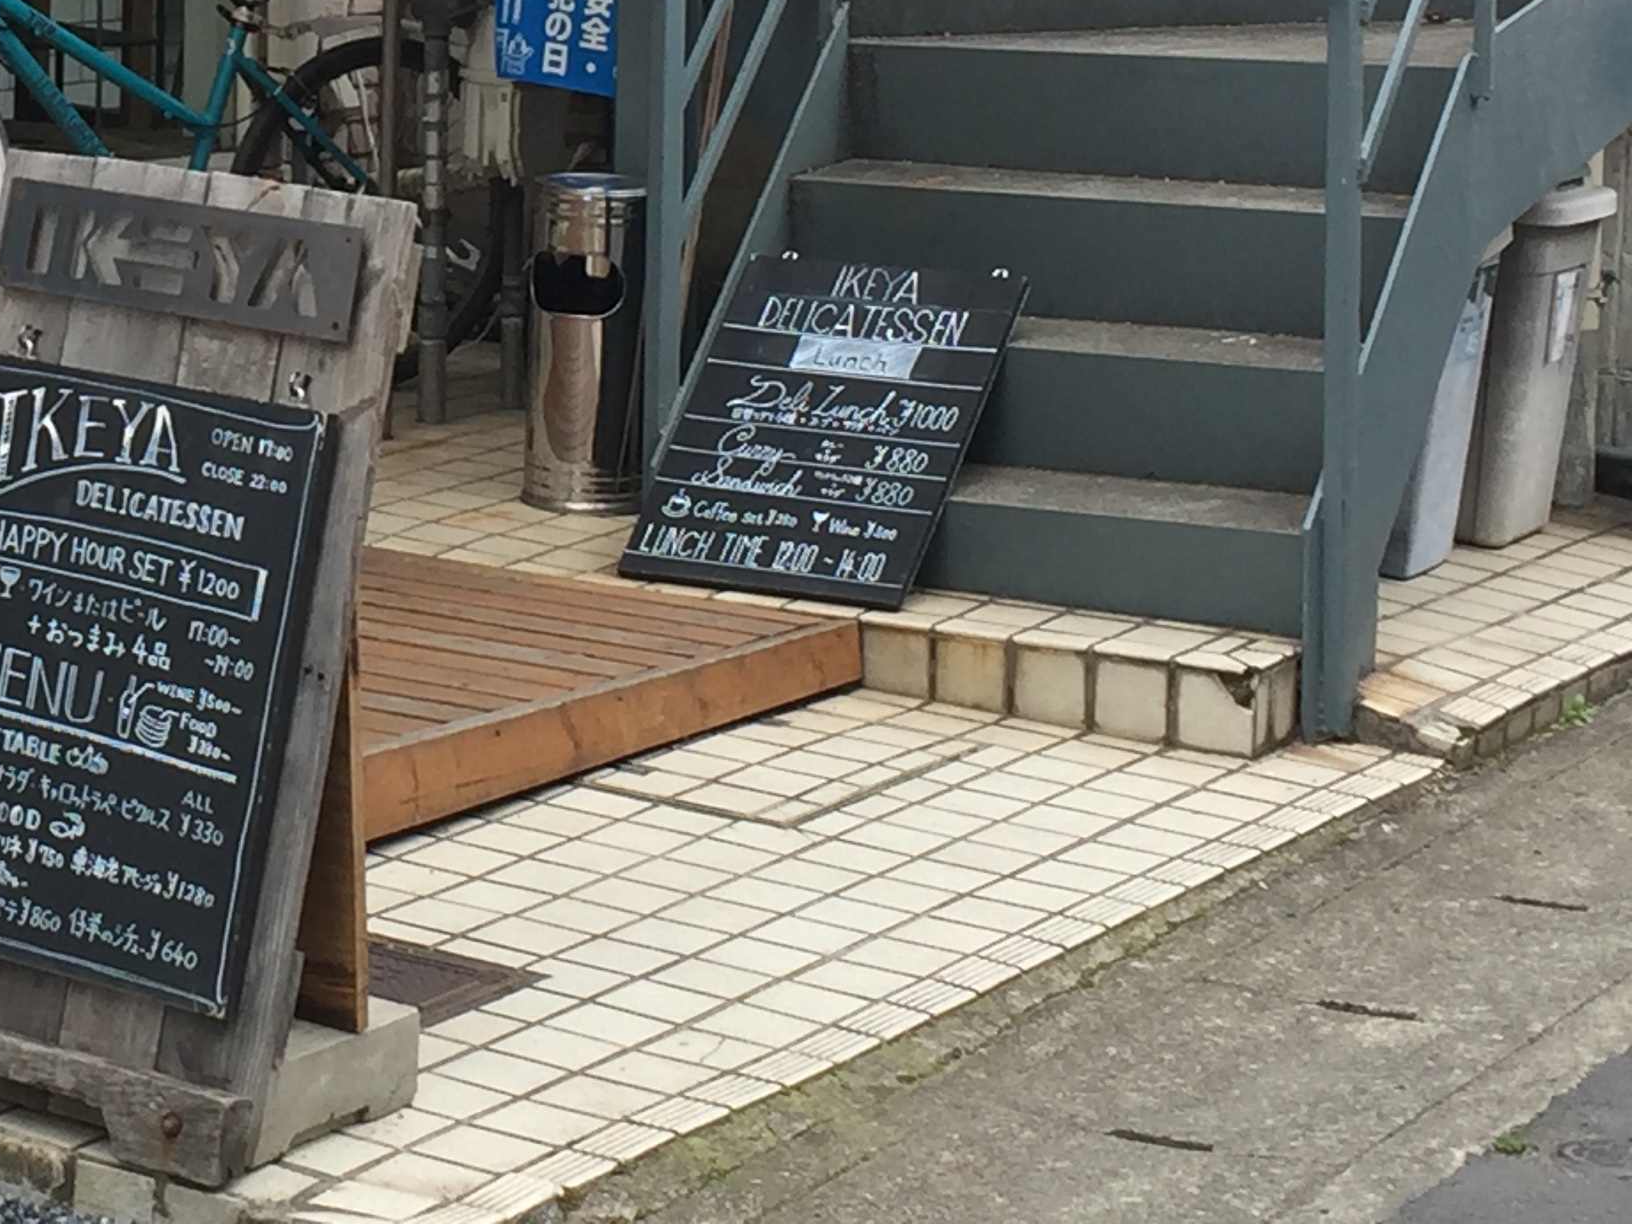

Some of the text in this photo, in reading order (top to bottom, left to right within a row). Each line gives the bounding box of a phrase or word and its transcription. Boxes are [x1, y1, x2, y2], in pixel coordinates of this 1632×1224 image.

[26, 202, 317, 317] IKEYA
[831, 265, 918, 305] IKEYA
[758, 296, 969, 347] DELICATESSEN
[813, 343, 887, 372] Lunch
[726, 375, 814, 412] Deli
[812, 385, 897, 424] Lunch
[211, 428, 254, 454] OPEN
[718, 424, 796, 475] Curry
[201, 461, 287, 494] CLOSE 22:00
[75, 478, 245, 541] DELICATESSEN
[693, 501, 737, 523] Coffee
[69, 536, 126, 574] HOUR
[129, 551, 174, 586] SET
[639, 522, 716, 560] LUNCH
[719, 532, 770, 568] TIME
[157, 680, 195, 703] WINE
[179, 711, 217, 738] FOOD
[181, 789, 214, 814] ALL
